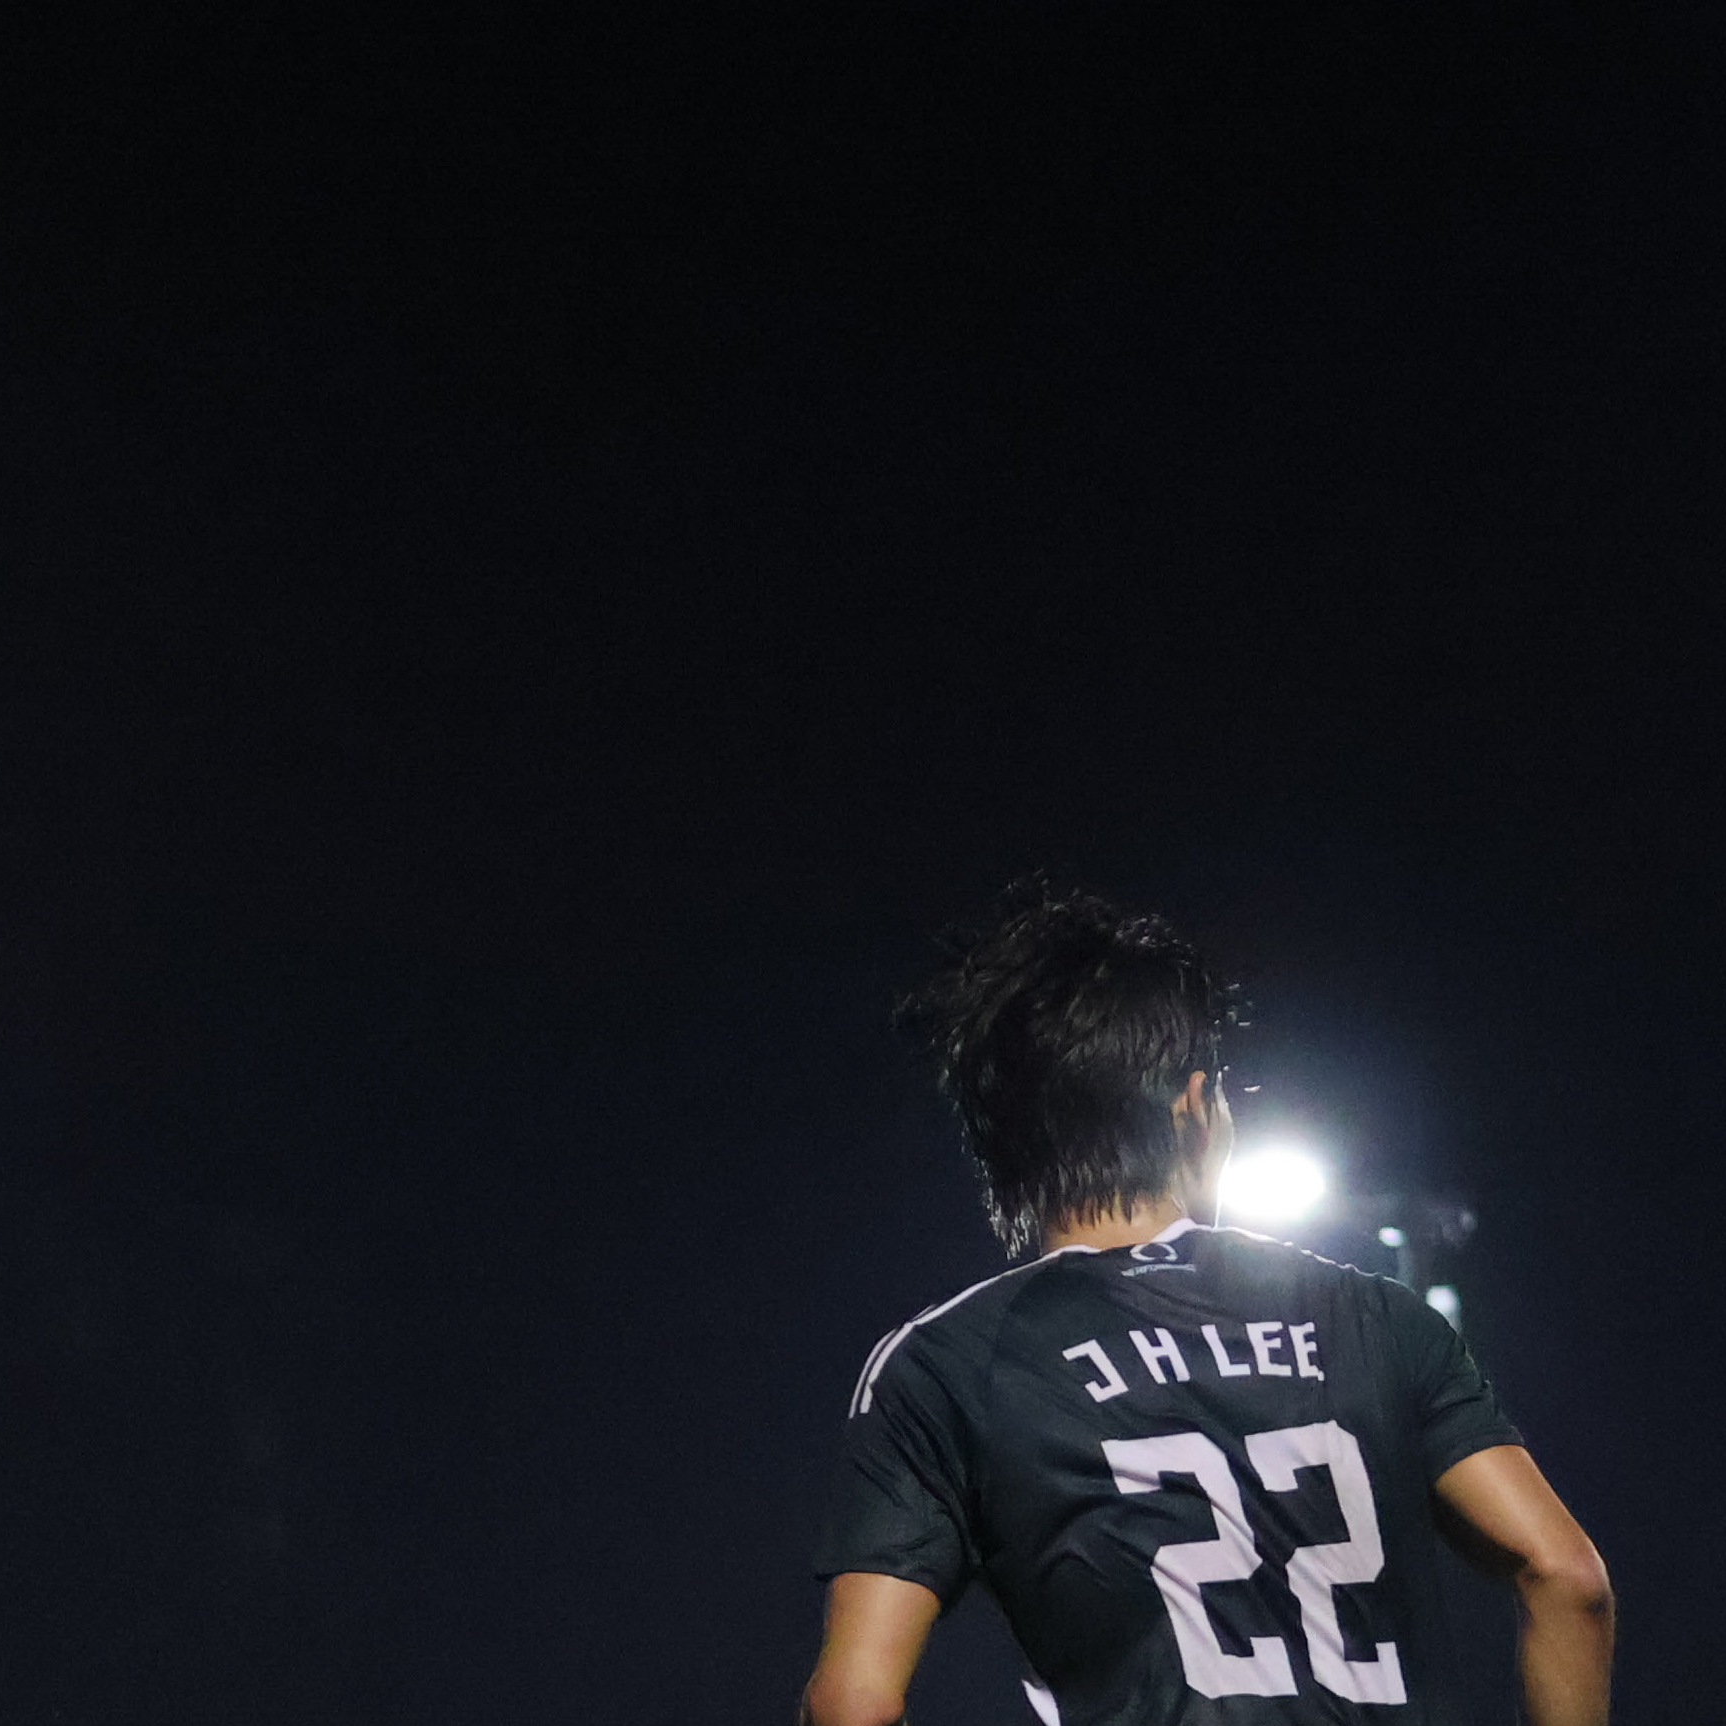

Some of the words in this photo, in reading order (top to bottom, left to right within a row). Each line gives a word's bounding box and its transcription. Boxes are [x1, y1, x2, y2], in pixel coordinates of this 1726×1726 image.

[1062, 1339, 1129, 1403] J
[1128, 1327, 1191, 1385] H
[1200, 1320, 1325, 1383] LEE
[1099, 1419, 1408, 1705] 22
